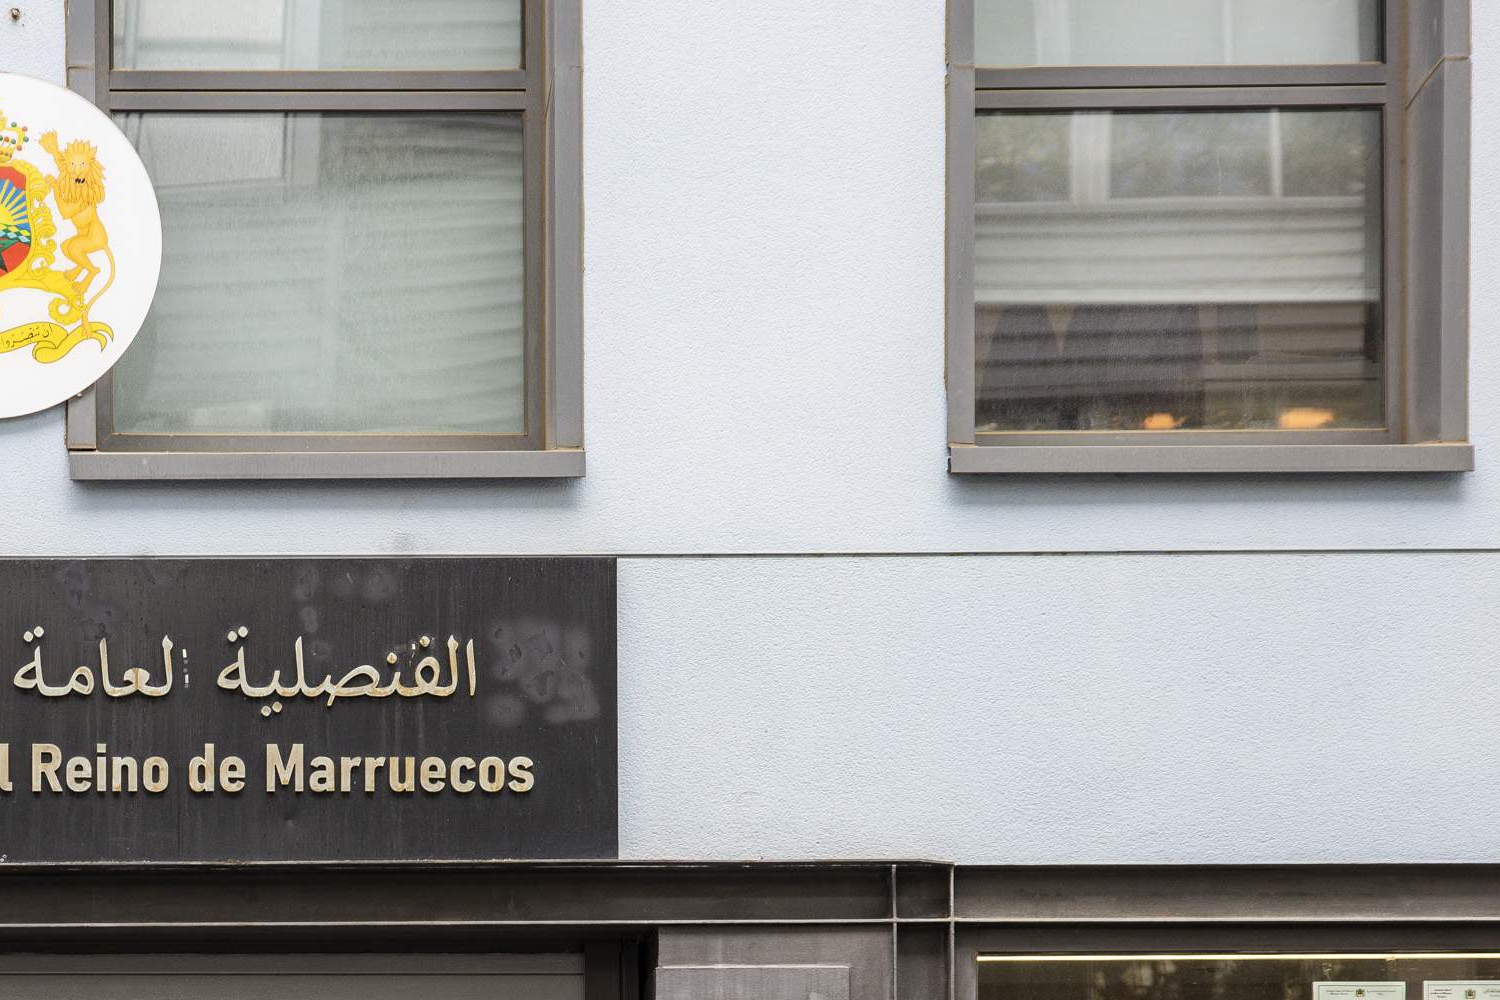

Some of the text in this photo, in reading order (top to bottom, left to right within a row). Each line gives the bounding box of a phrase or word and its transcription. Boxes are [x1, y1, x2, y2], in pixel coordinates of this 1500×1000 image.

[14, 626, 190, 697] لعامة
[32, 743, 169, 793] Reino
[189, 743, 246, 792] de
[267, 744, 535, 793] Marruecos
